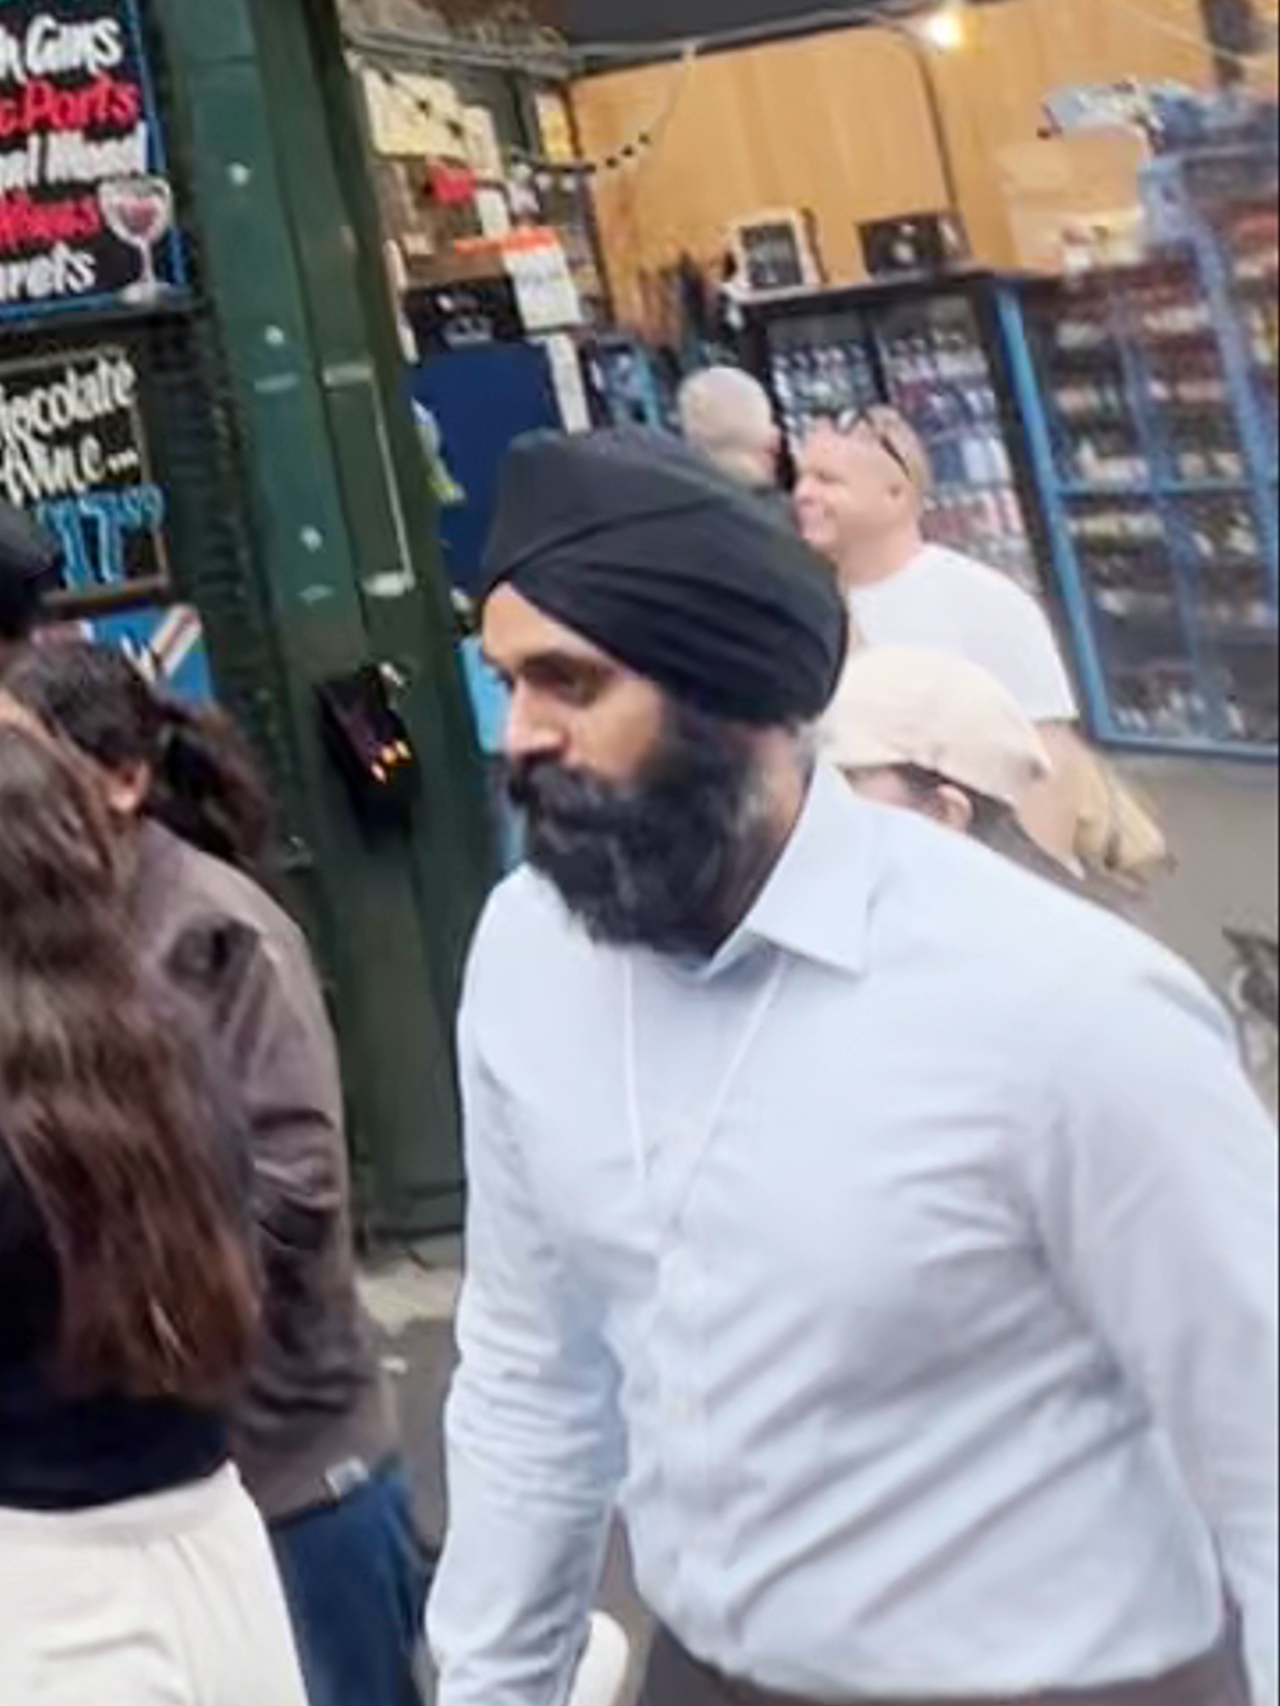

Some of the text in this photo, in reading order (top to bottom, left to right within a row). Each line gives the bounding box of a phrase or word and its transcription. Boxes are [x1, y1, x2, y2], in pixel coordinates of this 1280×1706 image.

[25, 14, 124, 77] Gins
[20, 73, 139, 132] Ports
[45, 123, 149, 184] Mead
